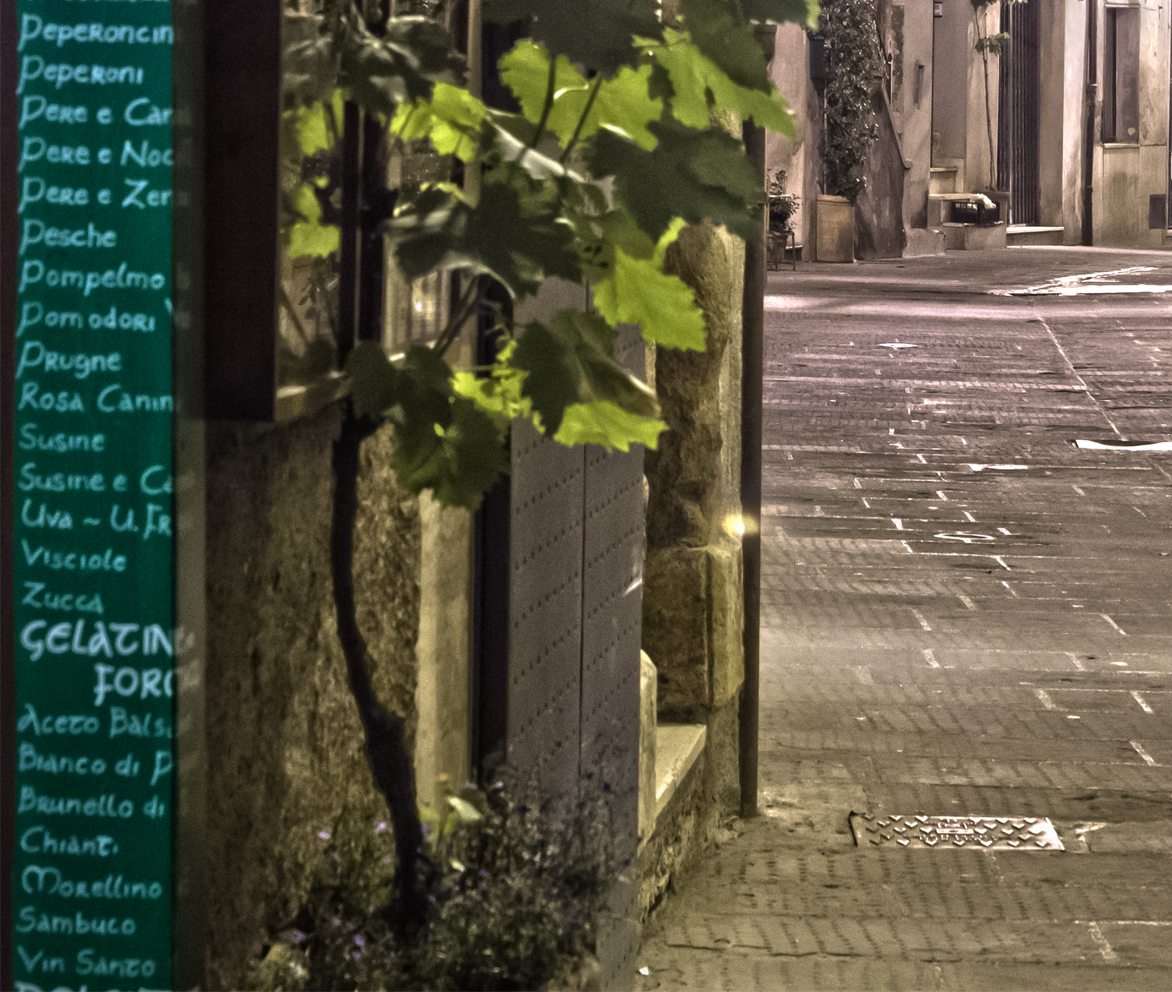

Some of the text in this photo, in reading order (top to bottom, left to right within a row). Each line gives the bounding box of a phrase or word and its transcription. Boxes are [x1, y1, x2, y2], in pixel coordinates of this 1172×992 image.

[16, 55, 144, 94] Peperoni
[18, 95, 88, 129] Pere
[96, 106, 113, 124] e
[17, 136, 90, 172] Pere
[97, 146, 112, 164] e
[17, 176, 89, 214] Pere
[97, 188, 112, 205] e
[18, 218, 118, 256] Pesche
[18, 259, 166, 296] Pompelmo
[15, 340, 122, 379] Prugne
[18, 382, 84, 412] Rosa
[18, 422, 105, 452] Susine
[18, 461, 105, 491] Susine
[113, 473, 127, 491] e
[21, 580, 104, 614] Zucca
[114, 753, 141, 777] di
[143, 794, 165, 818] di
[16, 906, 137, 935] Sambuco
[16, 945, 66, 973] Vin
